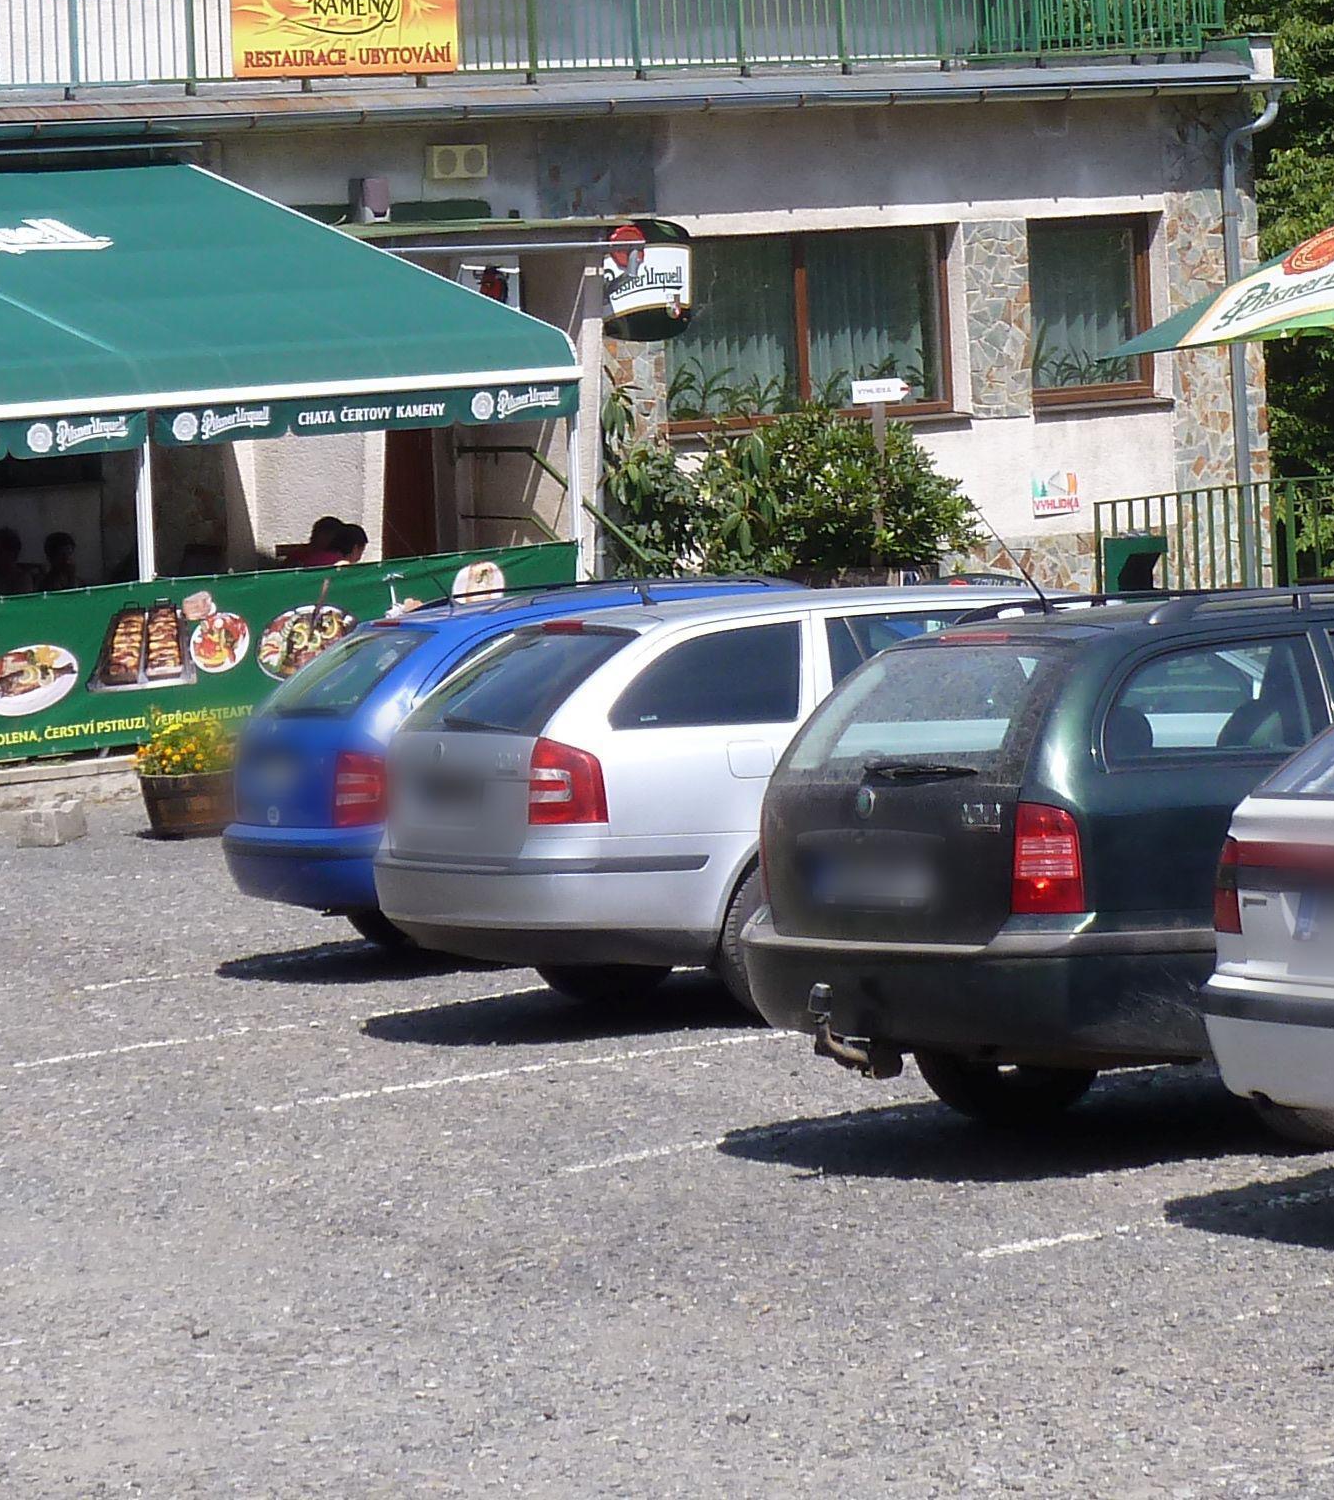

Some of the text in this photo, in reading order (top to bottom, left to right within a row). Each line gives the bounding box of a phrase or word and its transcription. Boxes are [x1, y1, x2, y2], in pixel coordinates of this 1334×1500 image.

[244, 49, 347, 68] RESTAURACE
[359, 41, 452, 65] UBYTOVÁNÍ
[644, 265, 683, 292] Urquell
[1213, 274, 1329, 331] Pilsner
[298, 403, 446, 426] CHATA ČERTOVY KAMENY
[44, 719, 95, 740] ČERSTVÍ
[97, 716, 150, 733] PSTRUZI,
[208, 704, 254, 720] STEAKY
